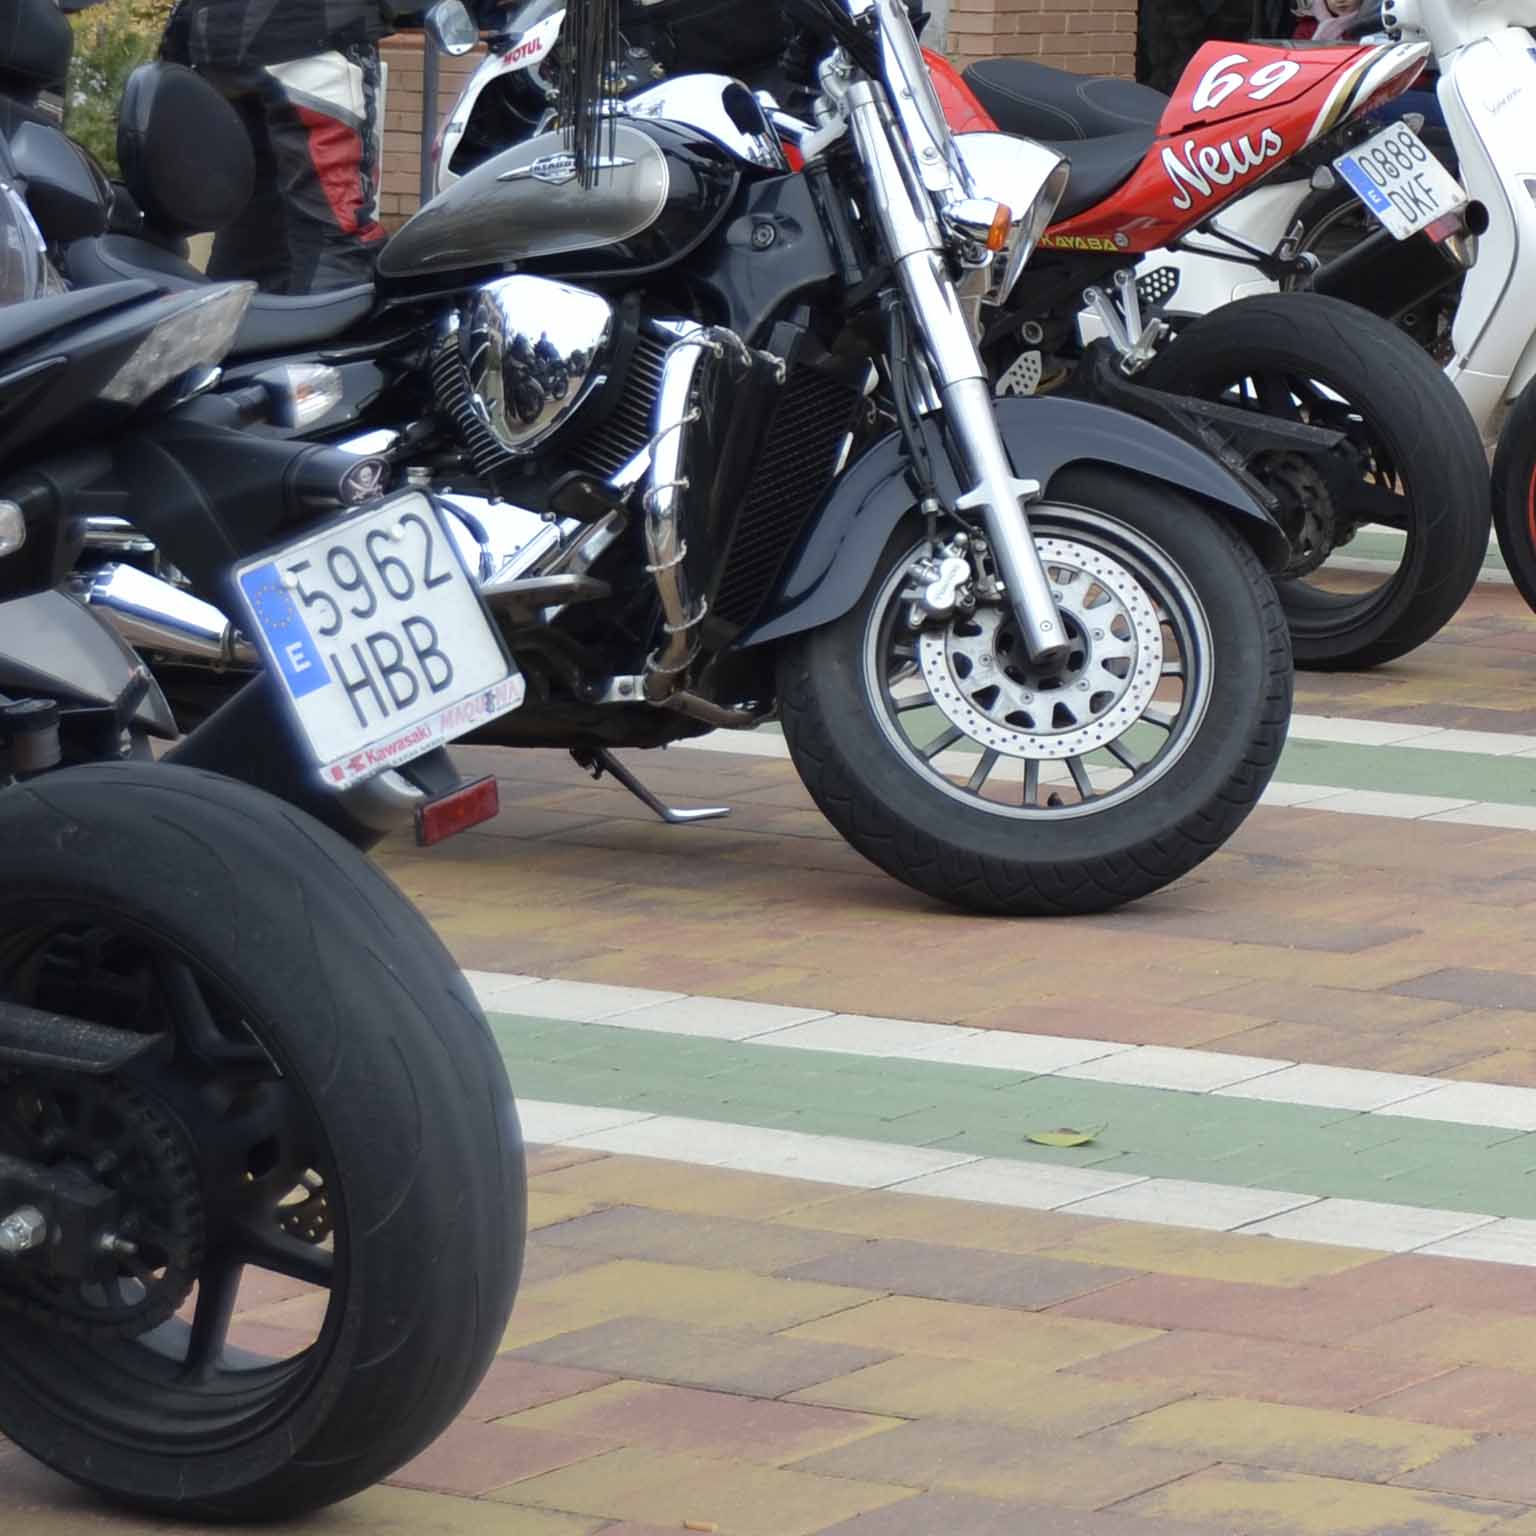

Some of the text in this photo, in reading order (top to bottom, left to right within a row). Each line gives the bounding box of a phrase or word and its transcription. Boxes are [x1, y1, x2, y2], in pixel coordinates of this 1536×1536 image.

[502, 37, 543, 64] MOTUL
[1191, 53, 1300, 113] 69
[1160, 127, 1283, 210] Neus
[1358, 131, 1427, 187] 0888
[1387, 172, 1440, 224] DKF
[287, 512, 453, 637] 5962
[286, 641, 312, 673] E
[330, 615, 454, 729] HBB
[366, 722, 433, 765] Kawasaki
